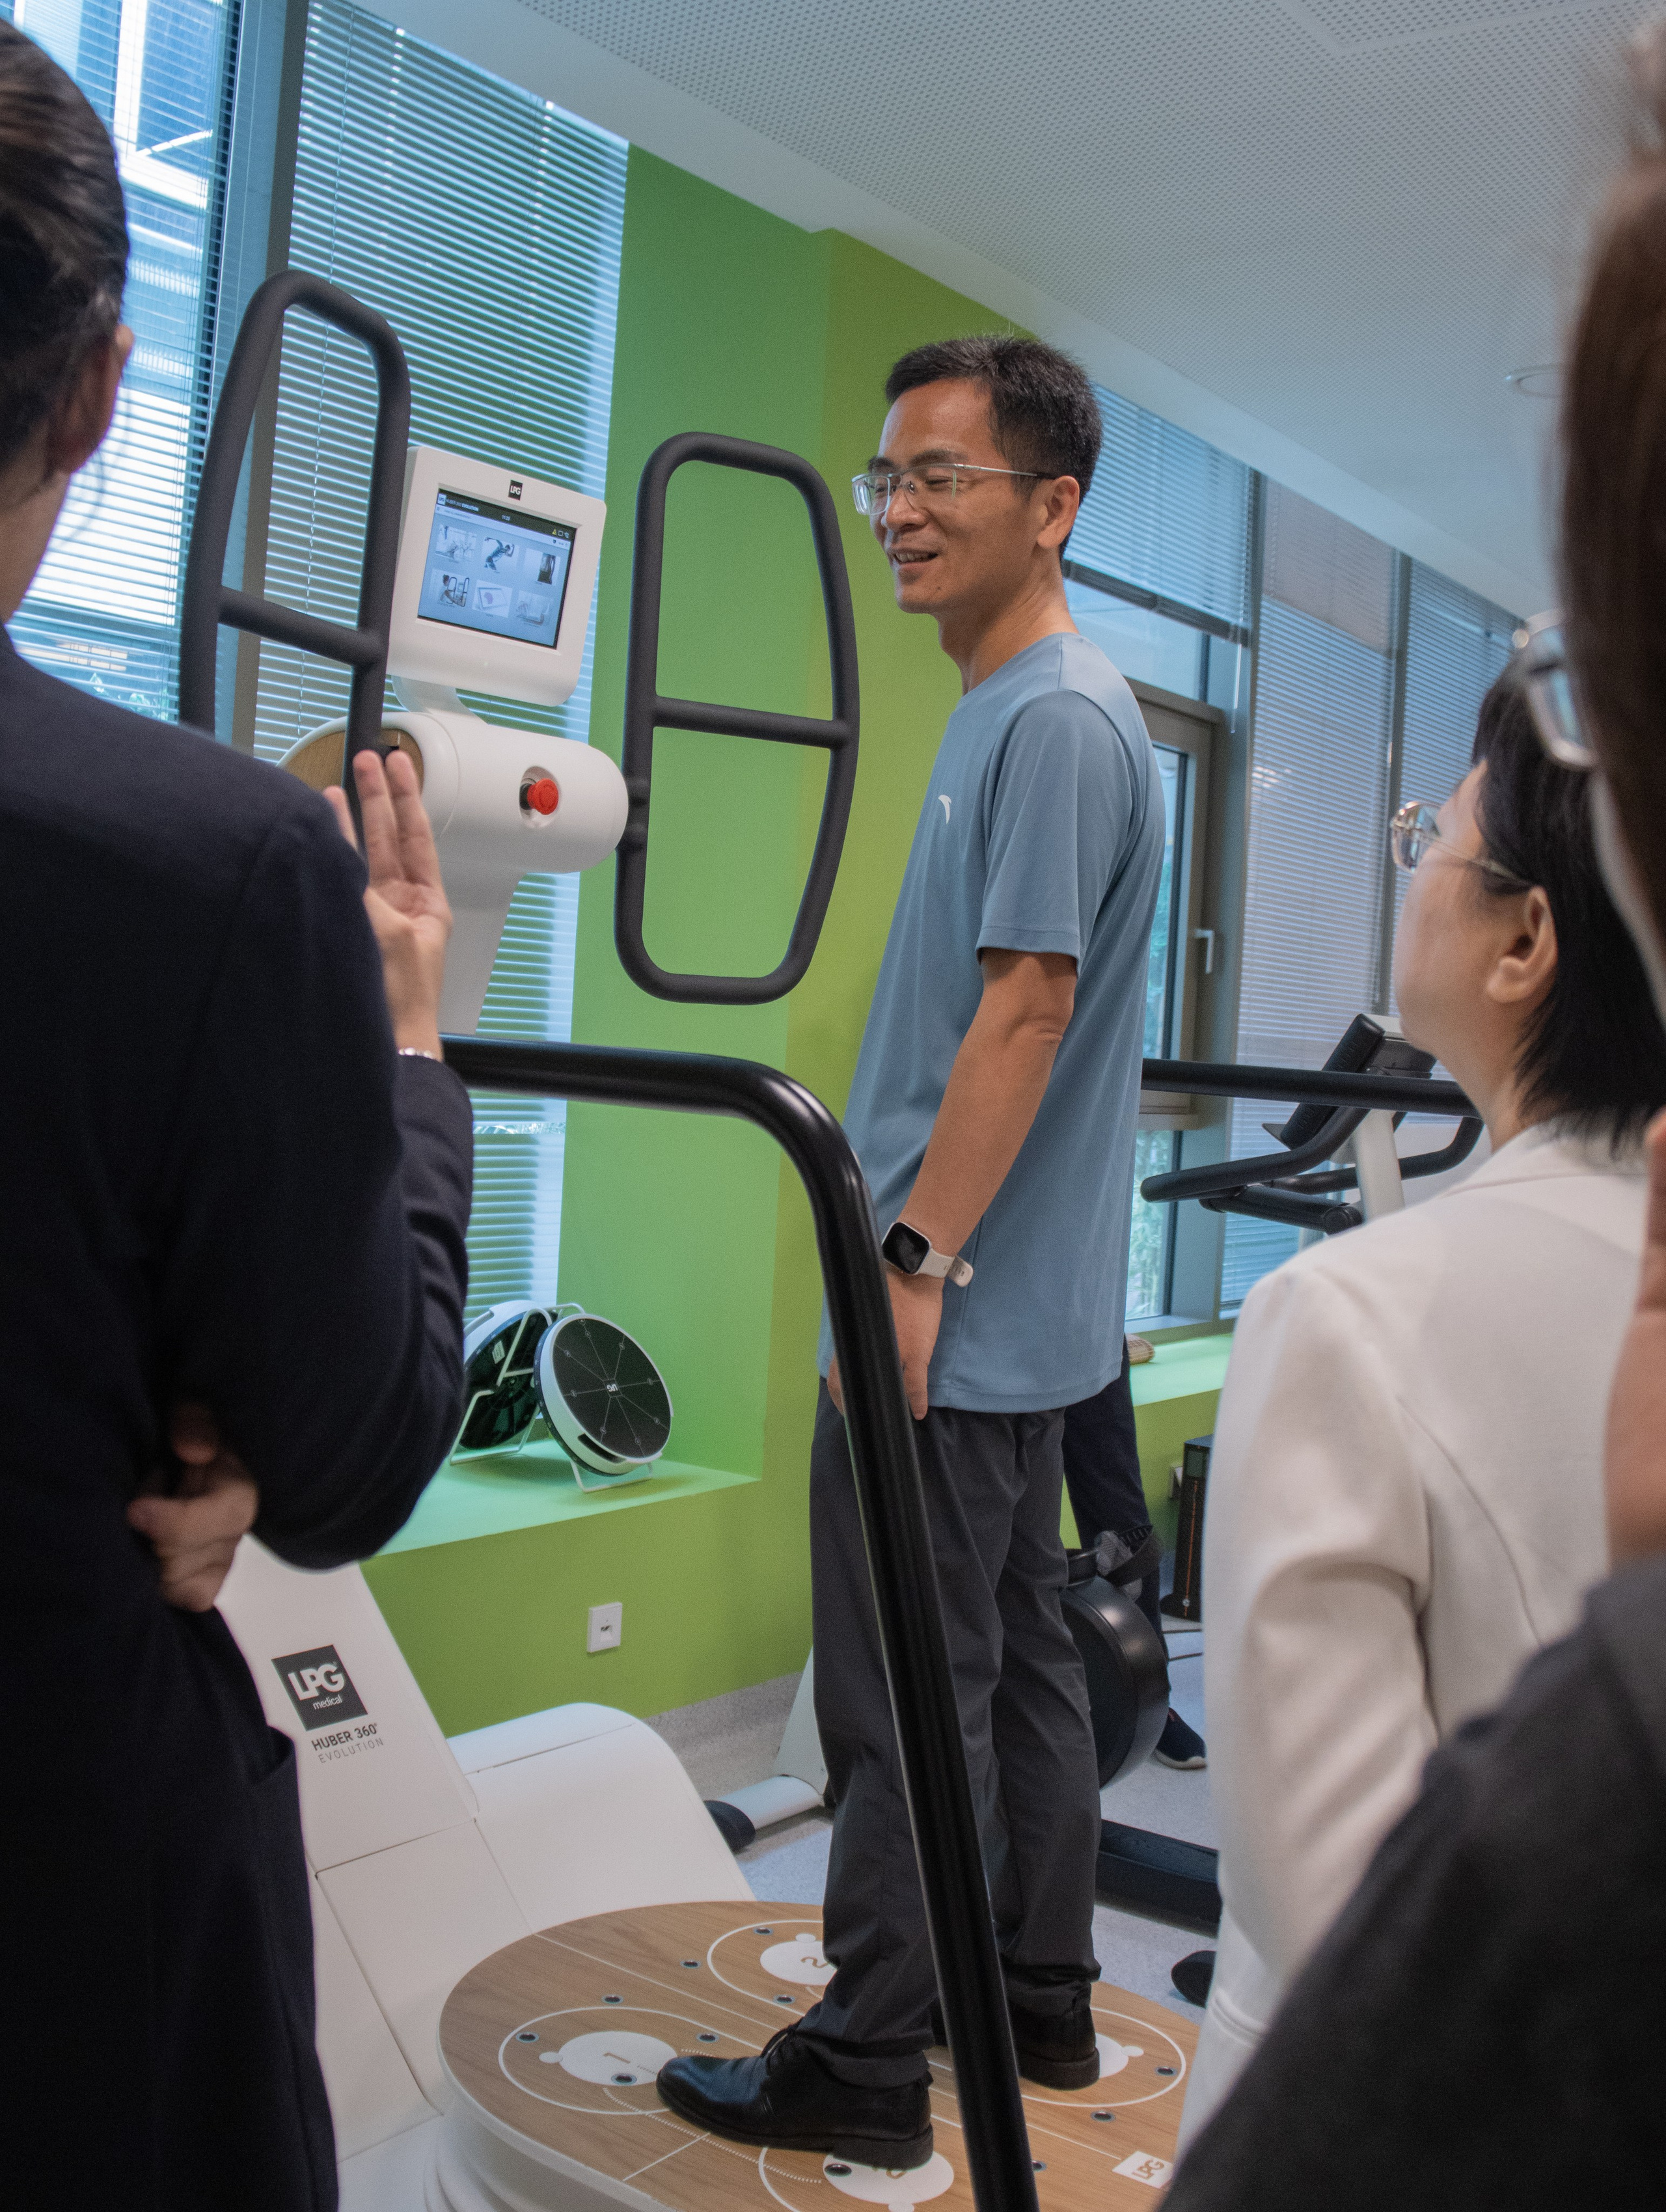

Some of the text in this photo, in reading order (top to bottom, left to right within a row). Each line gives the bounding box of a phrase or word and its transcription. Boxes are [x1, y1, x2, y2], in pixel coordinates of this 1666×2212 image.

[510, 485, 521, 495] LPG
[288, 1663, 345, 1700] LPG
[312, 1694, 343, 1710] medical
[311, 1730, 353, 1751] HUBER
[318, 1738, 384, 1764] EVOLUTION
[1132, 2159, 1165, 2180] LPG
